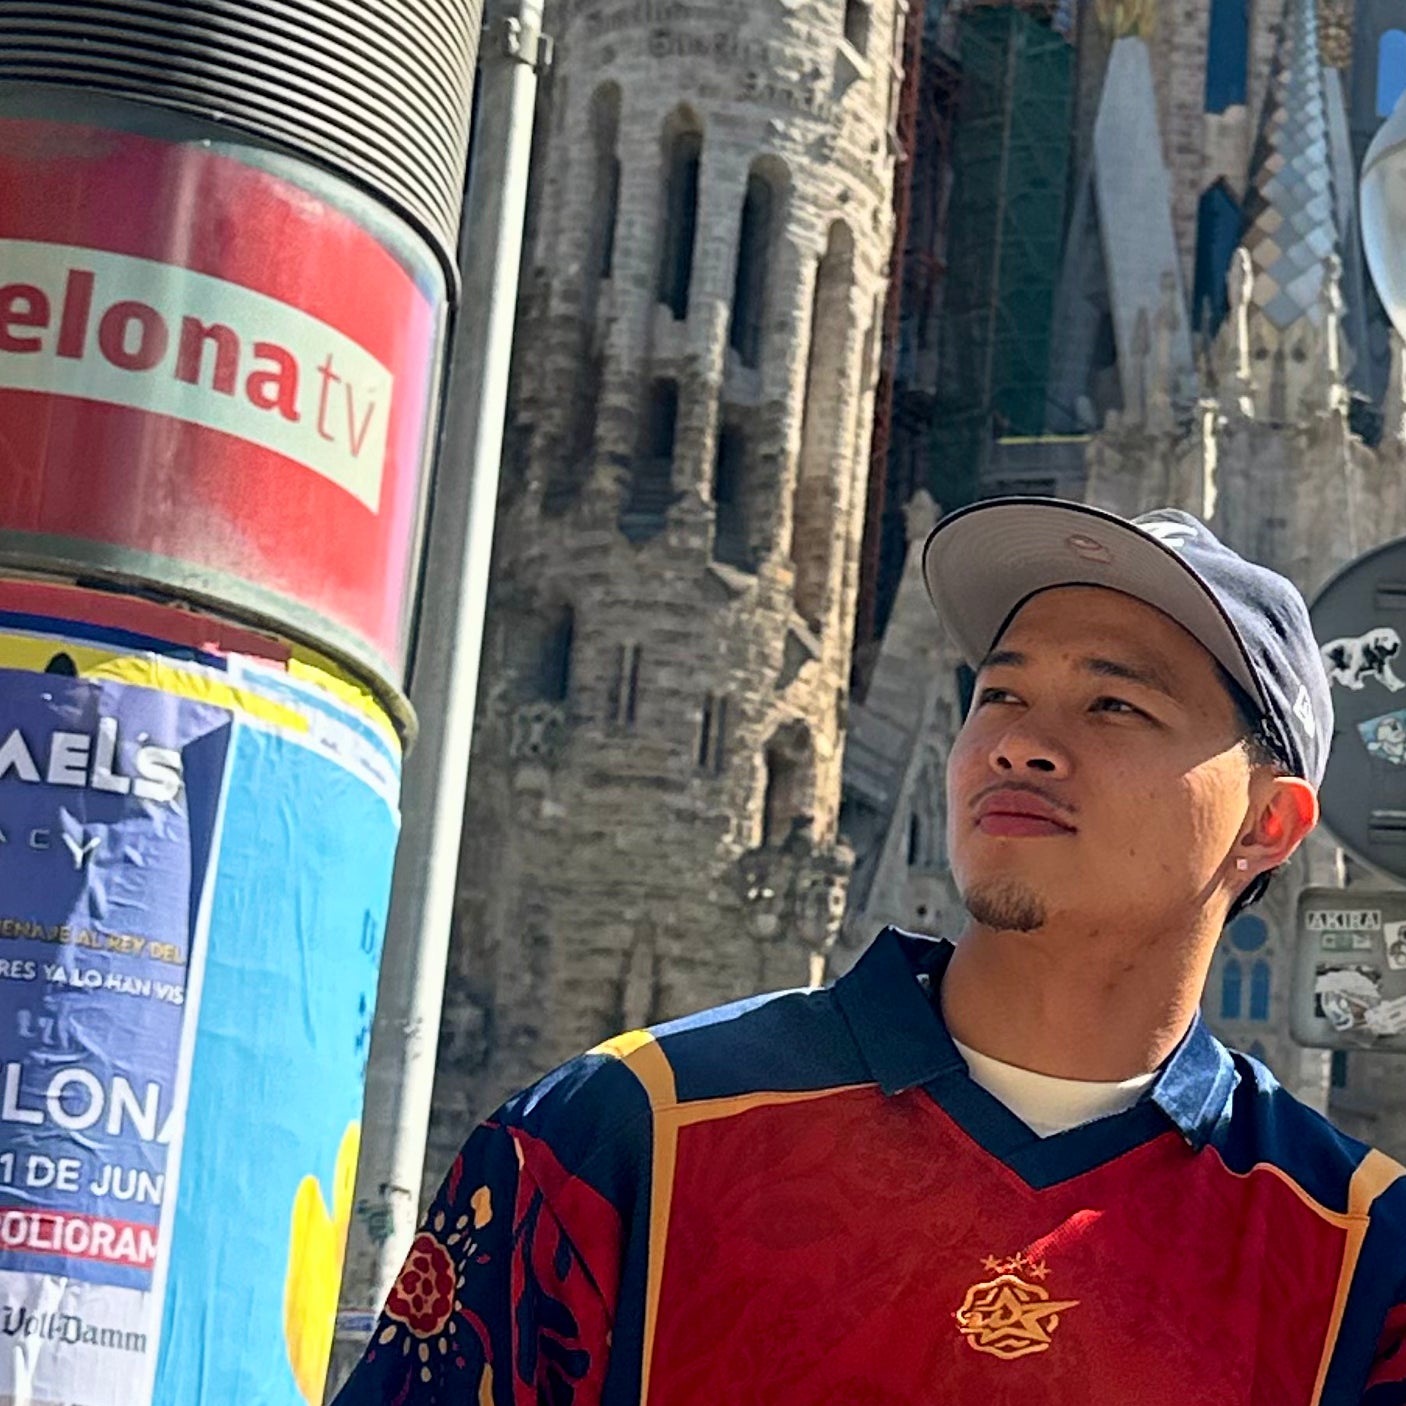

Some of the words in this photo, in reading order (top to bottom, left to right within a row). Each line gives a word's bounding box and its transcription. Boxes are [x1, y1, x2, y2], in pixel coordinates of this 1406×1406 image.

[1307, 910, 1378, 929] AKIRA
[26, 1154, 82, 1192] DE
[90, 1164, 165, 1206] JUN
[0, 1209, 159, 1264] OLIORAM
